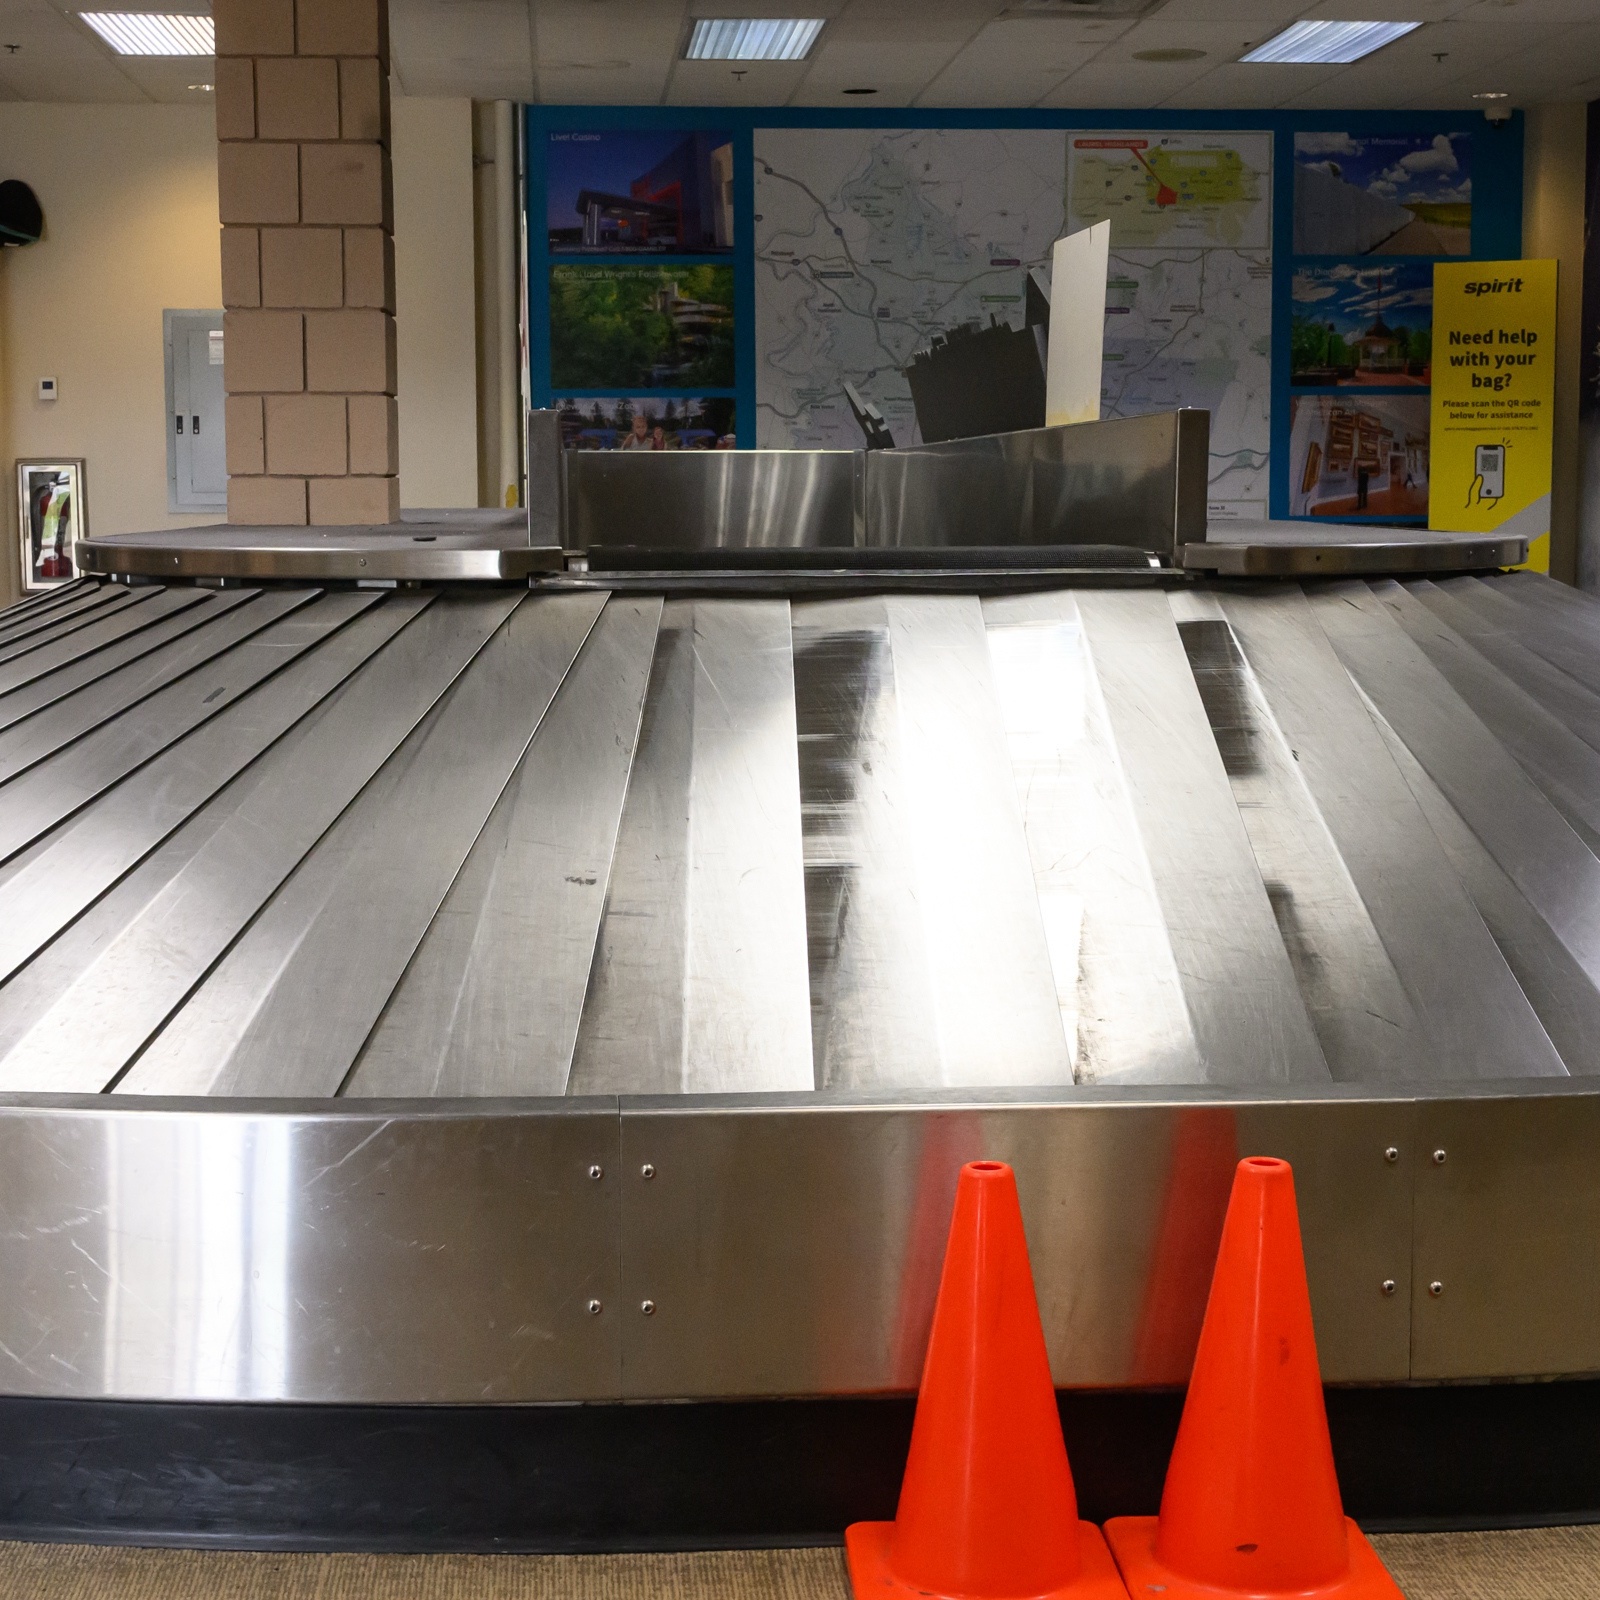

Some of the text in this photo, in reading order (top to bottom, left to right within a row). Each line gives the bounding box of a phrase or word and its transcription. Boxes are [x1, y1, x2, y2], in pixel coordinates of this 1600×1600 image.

[571, 132, 601, 141] Casino
[1464, 278, 1523, 297] spirit
[1449, 328, 1537, 347] Need help
[1450, 351, 1536, 370] with your
[1471, 373, 1512, 392] bag?
[1442, 400, 1470, 408] Please
[1507, 399, 1519, 408] QR
[1521, 399, 1541, 407] code
[1449, 411, 1475, 419] below
[1490, 410, 1533, 419] assistance
